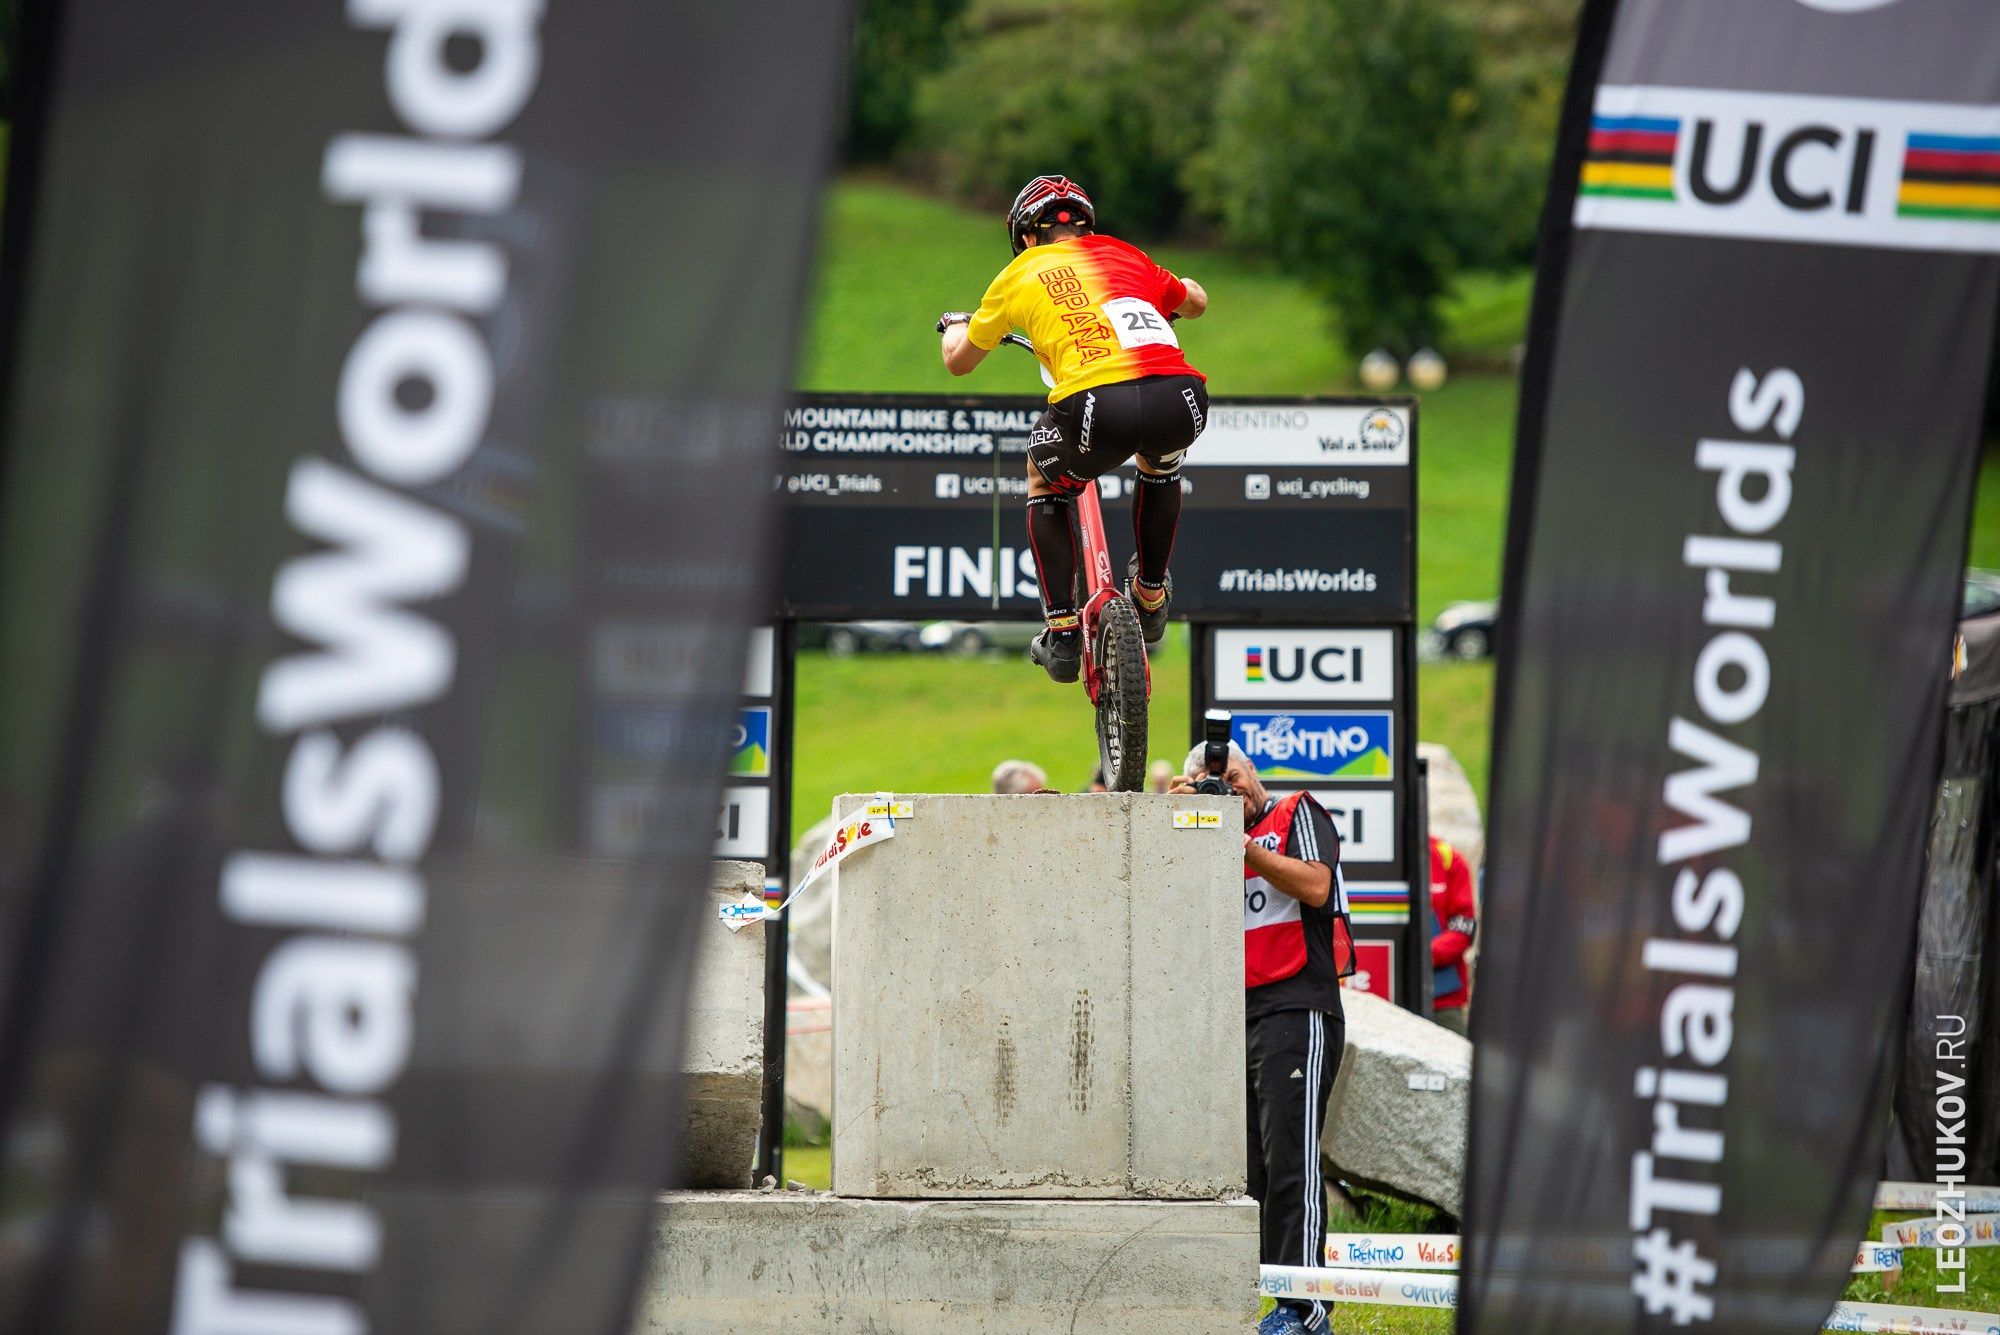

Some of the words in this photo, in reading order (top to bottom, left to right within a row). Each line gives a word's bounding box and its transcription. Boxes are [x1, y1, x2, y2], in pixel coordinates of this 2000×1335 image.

[1687, 117, 1878, 215] UCI
[1038, 265, 1112, 366] ESPAÑA
[1121, 311, 1162, 331] 2E
[783, 407, 897, 429] MOUNTAIN
[900, 409, 949, 430] BIKE
[952, 411, 969, 431] &
[971, 410, 1043, 432] TRIALS
[1210, 410, 1309, 431] TRENTINO
[813, 431, 994, 454] CHAMPIONSHIPS
[787, 473, 882, 496] @UCI_Trials
[963, 476, 994, 494] UCI
[997, 475, 1028, 495] Trial
[1276, 477, 1370, 499] uci_cycling
[893, 545, 1039, 598] FINIS
[1219, 567, 1378, 592] #TrialsWorlds
[1268, 647, 1363, 682] UCI
[1240, 722, 1370, 761] TRENTINO
[828, 842, 837, 858] di
[1629, 366, 1805, 1326] #TrialsWorlds
[1347, 1243, 1404, 1264] TRENTINO
[1417, 1242, 1436, 1263] Val
[1874, 1247, 1904, 1267] TRENT
